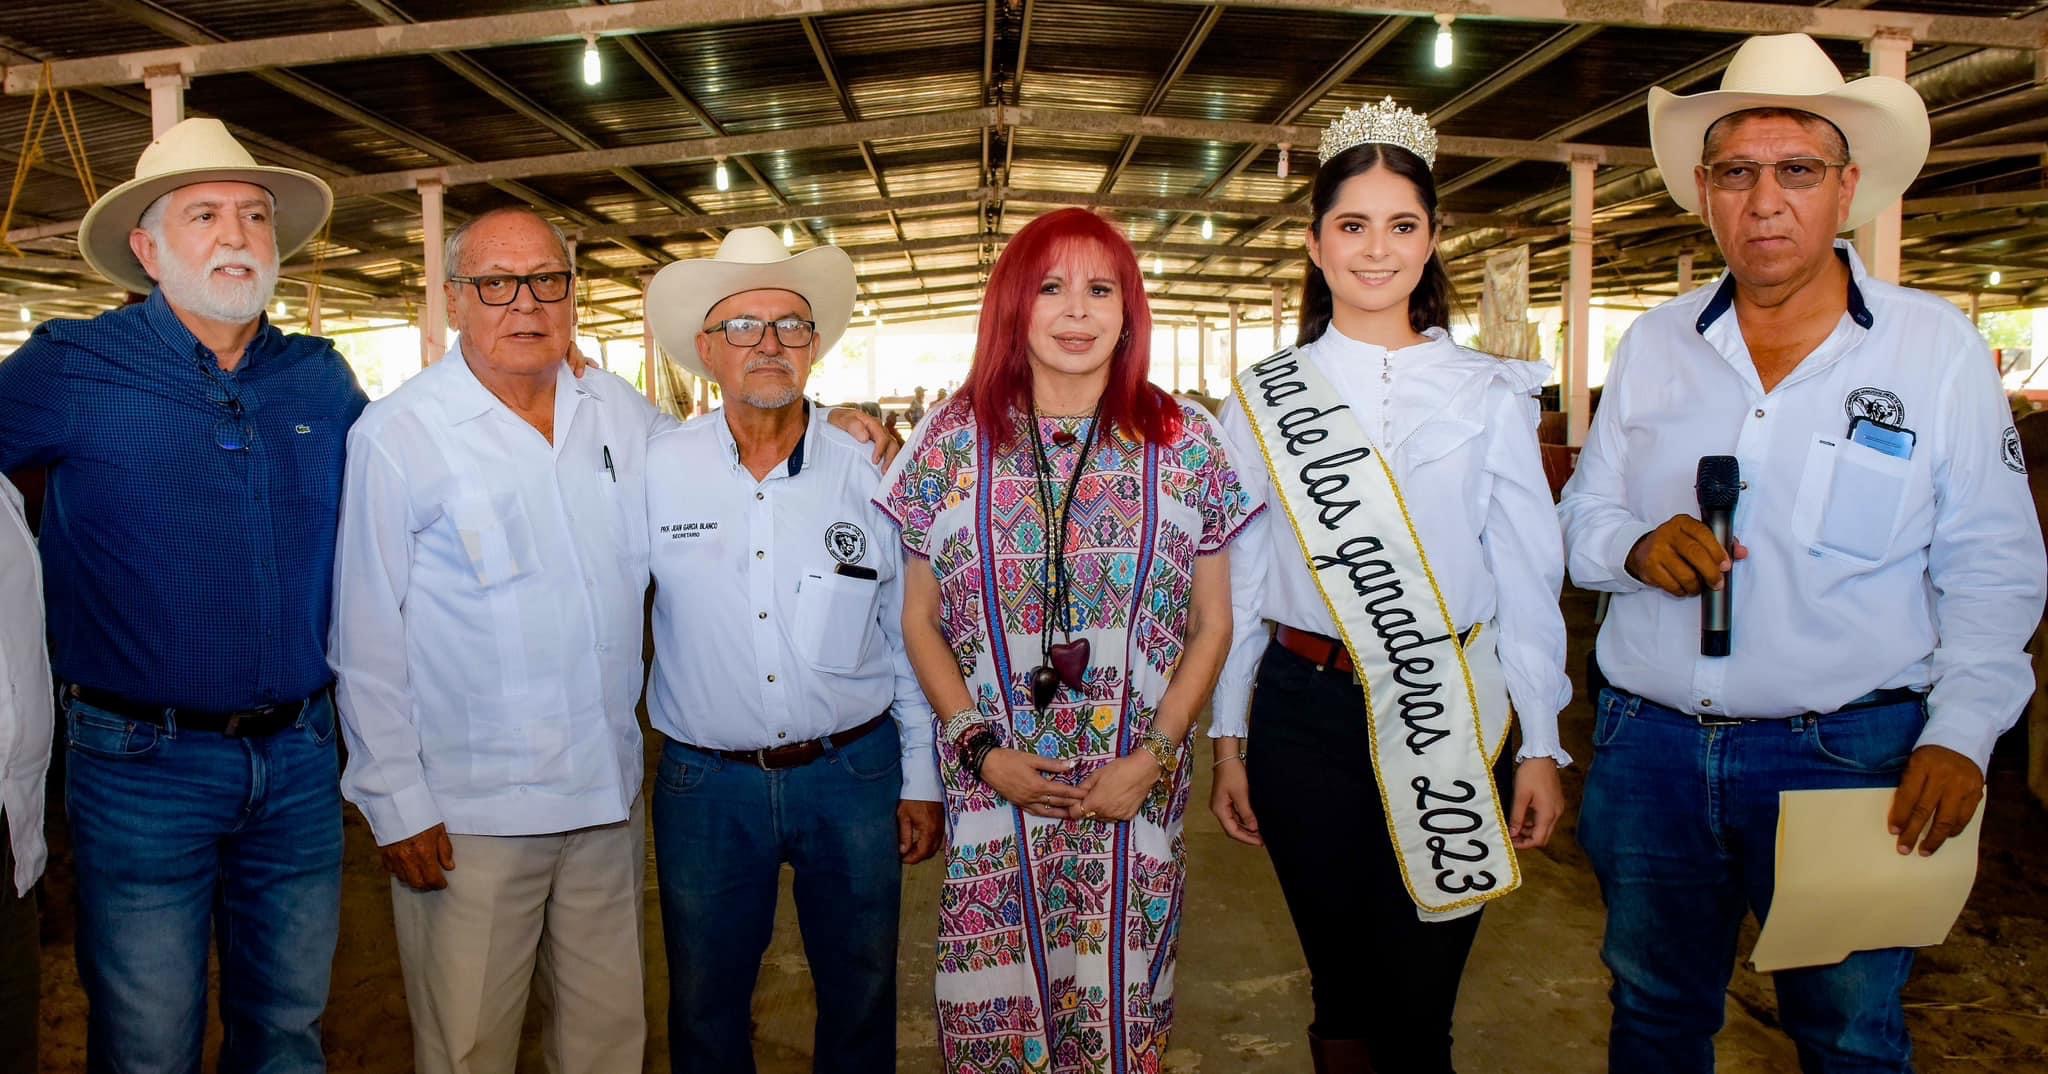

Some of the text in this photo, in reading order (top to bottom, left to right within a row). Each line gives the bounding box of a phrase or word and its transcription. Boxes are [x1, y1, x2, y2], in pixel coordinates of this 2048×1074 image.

[1277, 405, 1350, 456] de
[1300, 447, 1370, 530] los
[1307, 536, 1453, 756] ganaderos
[1411, 776, 1496, 893] 2023
